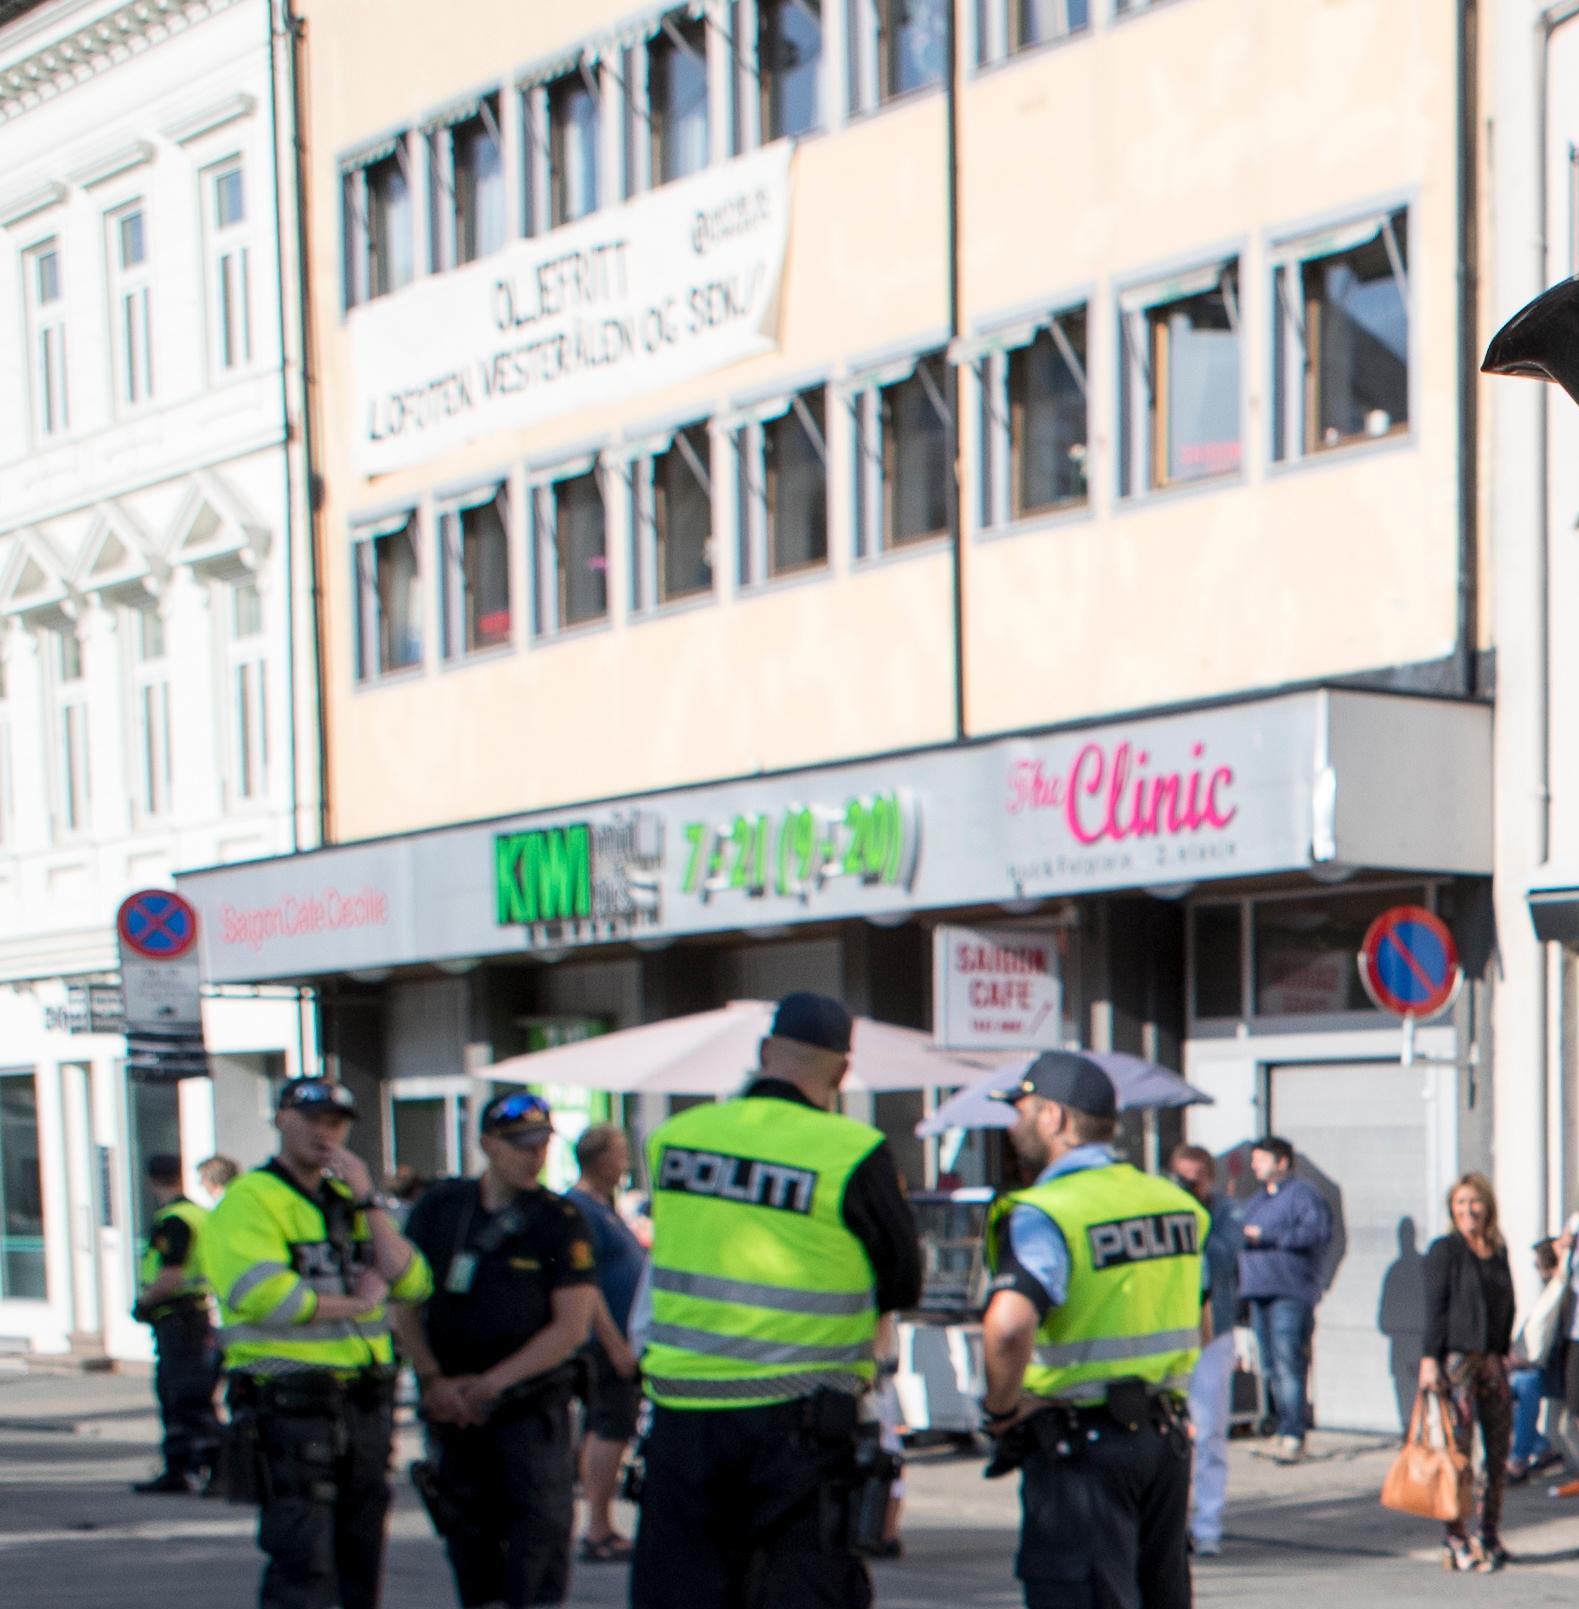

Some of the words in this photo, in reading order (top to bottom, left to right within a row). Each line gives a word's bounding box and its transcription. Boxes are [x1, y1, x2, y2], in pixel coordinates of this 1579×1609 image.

[1005, 758, 1060, 815] The
[1065, 739, 1239, 846] Clinic
[660, 1148, 814, 1212] POLITI
[1088, 1213, 1196, 1268] POLITI
